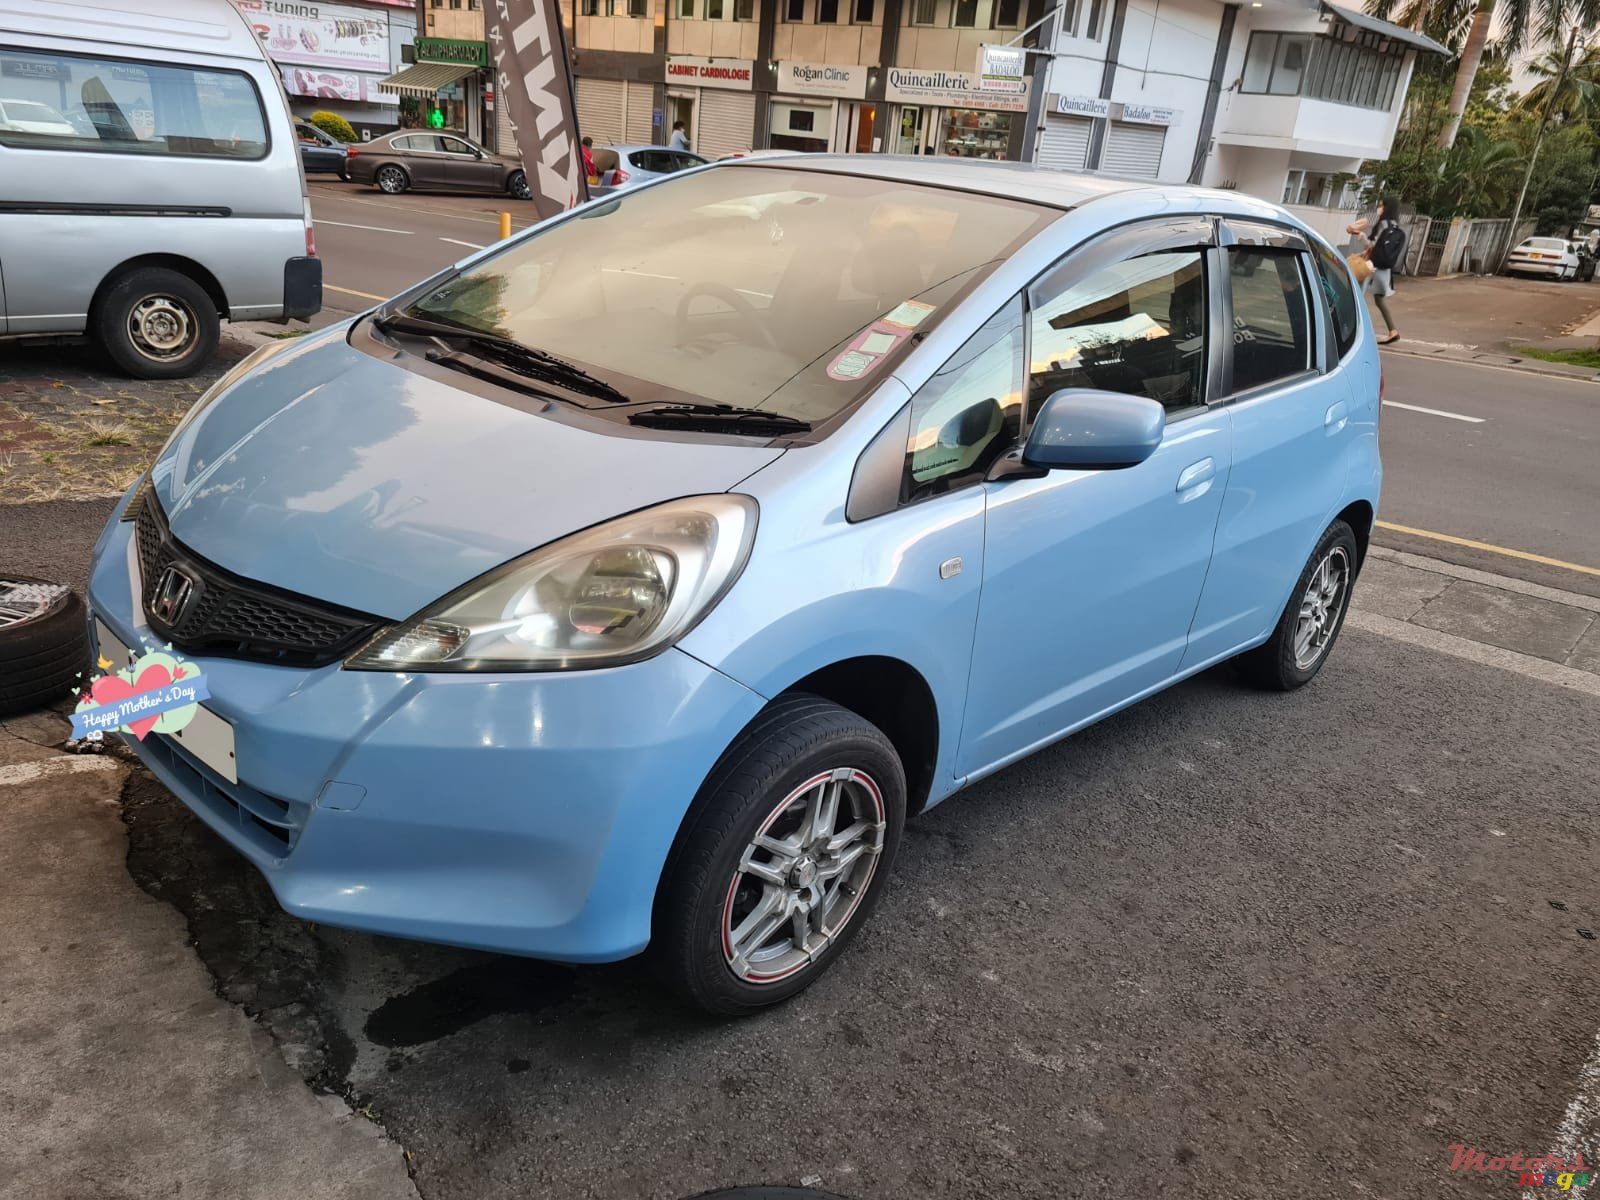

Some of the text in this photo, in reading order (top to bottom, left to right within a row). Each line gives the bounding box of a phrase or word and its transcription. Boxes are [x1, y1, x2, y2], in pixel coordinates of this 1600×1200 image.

[439, 44, 481, 61] PHARMACY
[668, 64, 750, 80] CABINET CARDIOLOGIE
[793, 65, 850, 81] Rogan Clinic
[890, 70, 969, 90] Quincaillerie
[1060, 96, 1107, 114] Quincaillerie
[1124, 106, 1150, 120] Badaloo
